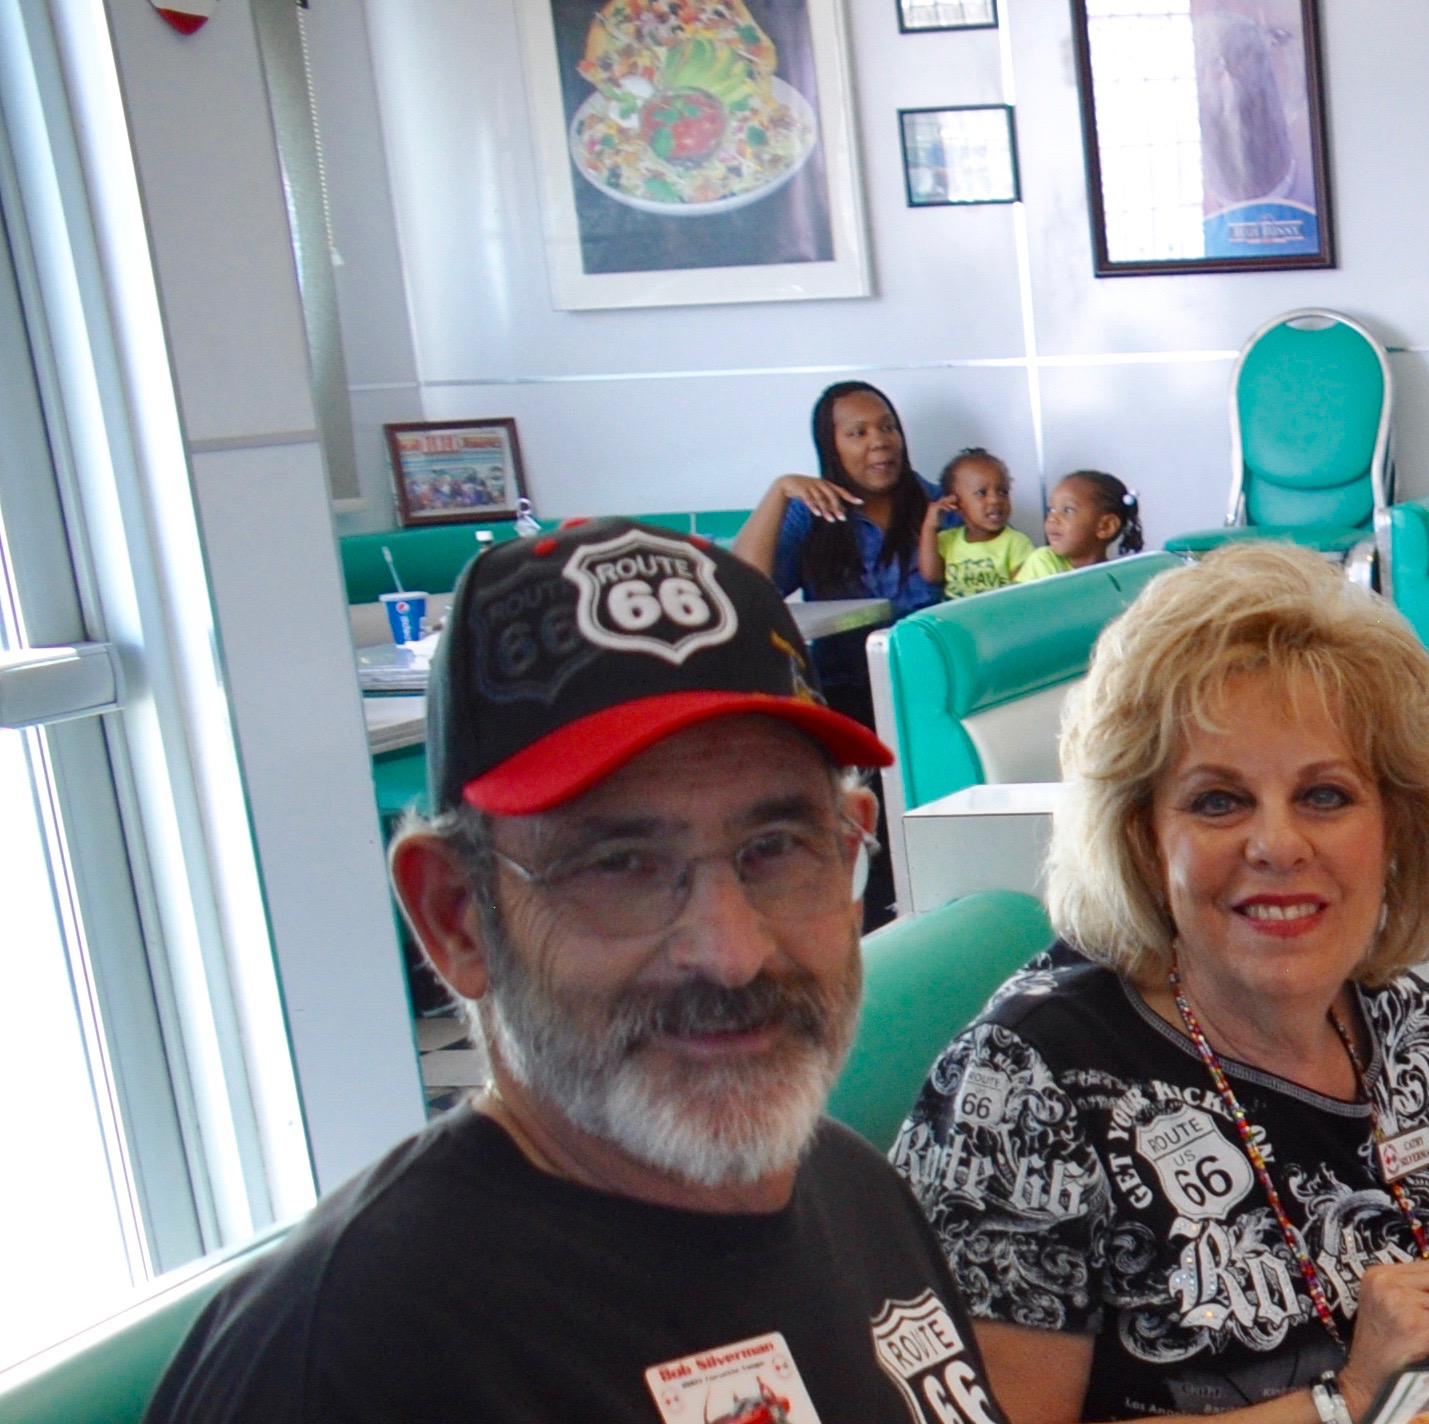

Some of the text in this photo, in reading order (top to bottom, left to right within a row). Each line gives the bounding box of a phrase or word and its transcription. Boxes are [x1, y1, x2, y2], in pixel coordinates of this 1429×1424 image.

[595, 555, 693, 586] ROUTE
[608, 579, 711, 631] 66
[968, 1073, 1001, 1088] ROUTE
[960, 1092, 993, 1120] 66
[1107, 1084, 1151, 1140] YOUR
[1147, 1117, 1204, 1154] ROUTE
[1173, 1149, 1196, 1167] US
[1009, 1152, 1089, 1216] 66
[1109, 1153, 1154, 1210] GET
[1174, 1155, 1234, 1207] 66
[659, 1340, 775, 1383] Bob Silverman
[886, 1319, 955, 1373] ROUTE
